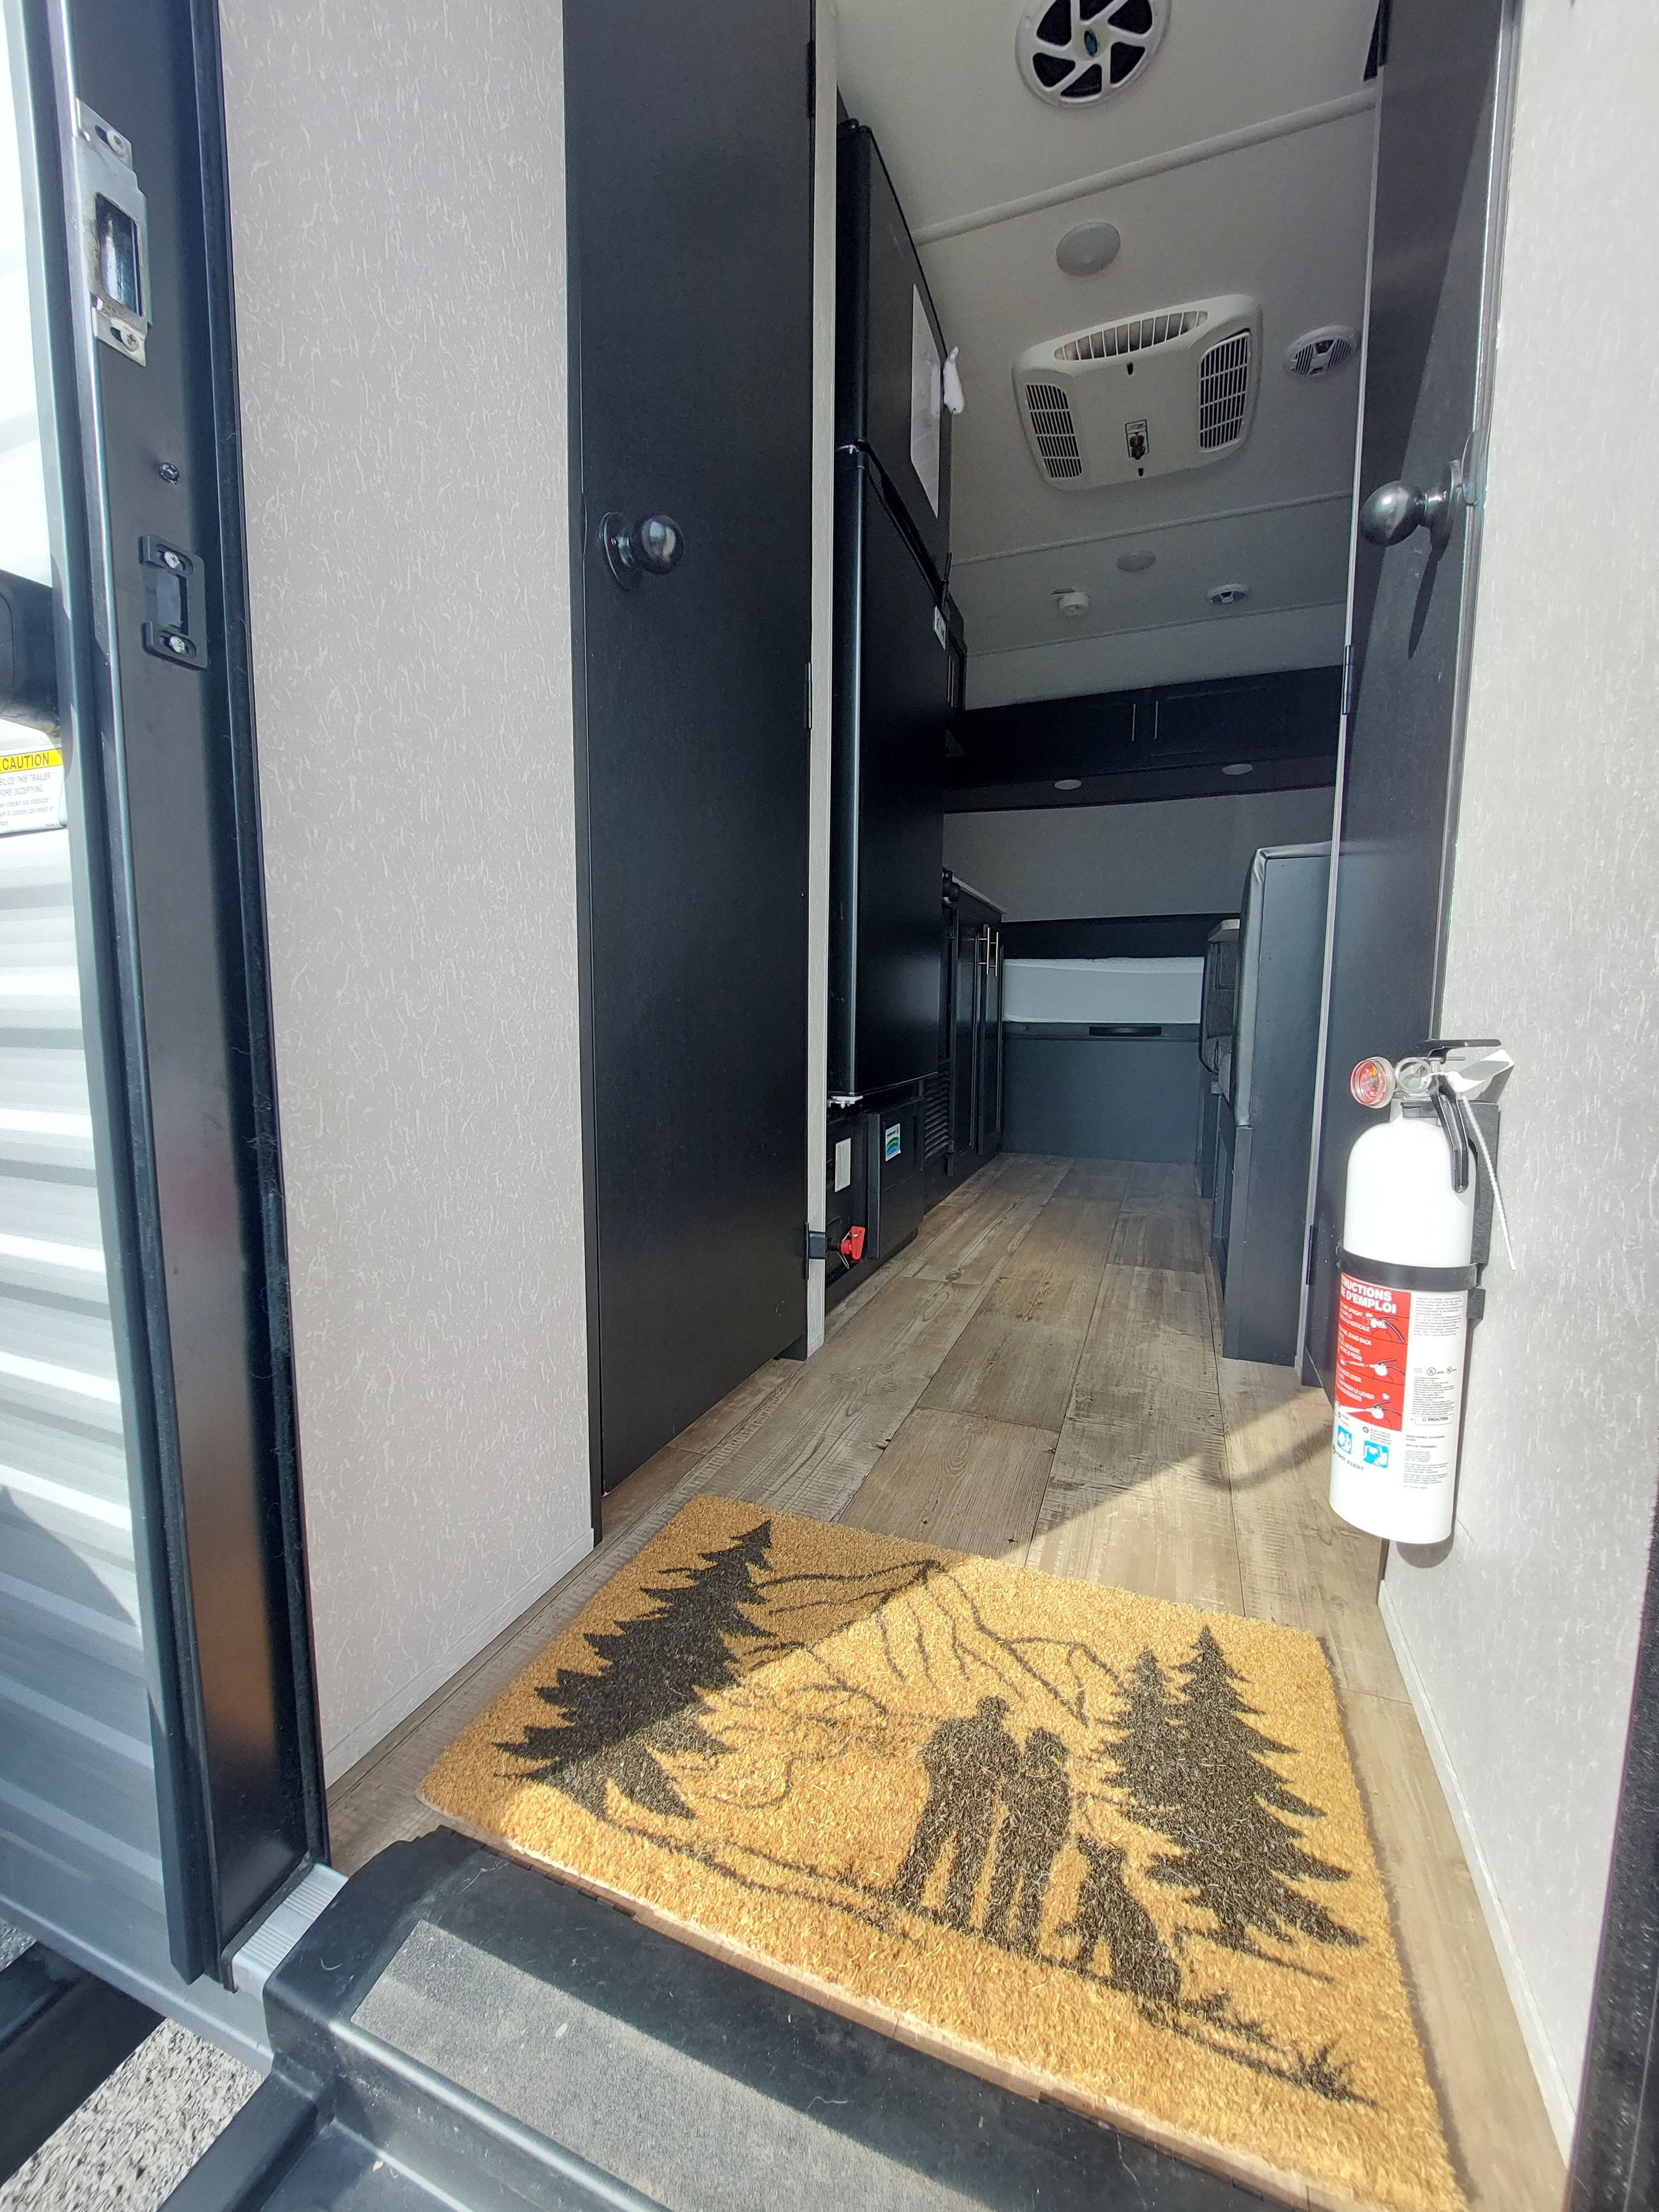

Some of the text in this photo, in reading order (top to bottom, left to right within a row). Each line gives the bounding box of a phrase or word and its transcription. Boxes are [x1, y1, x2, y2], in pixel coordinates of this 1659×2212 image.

[2, 752, 49, 770] CAUTION
[17, 775, 28, 783] THIS
[29, 772, 50, 781] TRAILER
[1346, 1290, 1397, 1314] D'EMPLOI
[1347, 1459, 1365, 1471] ALERT
